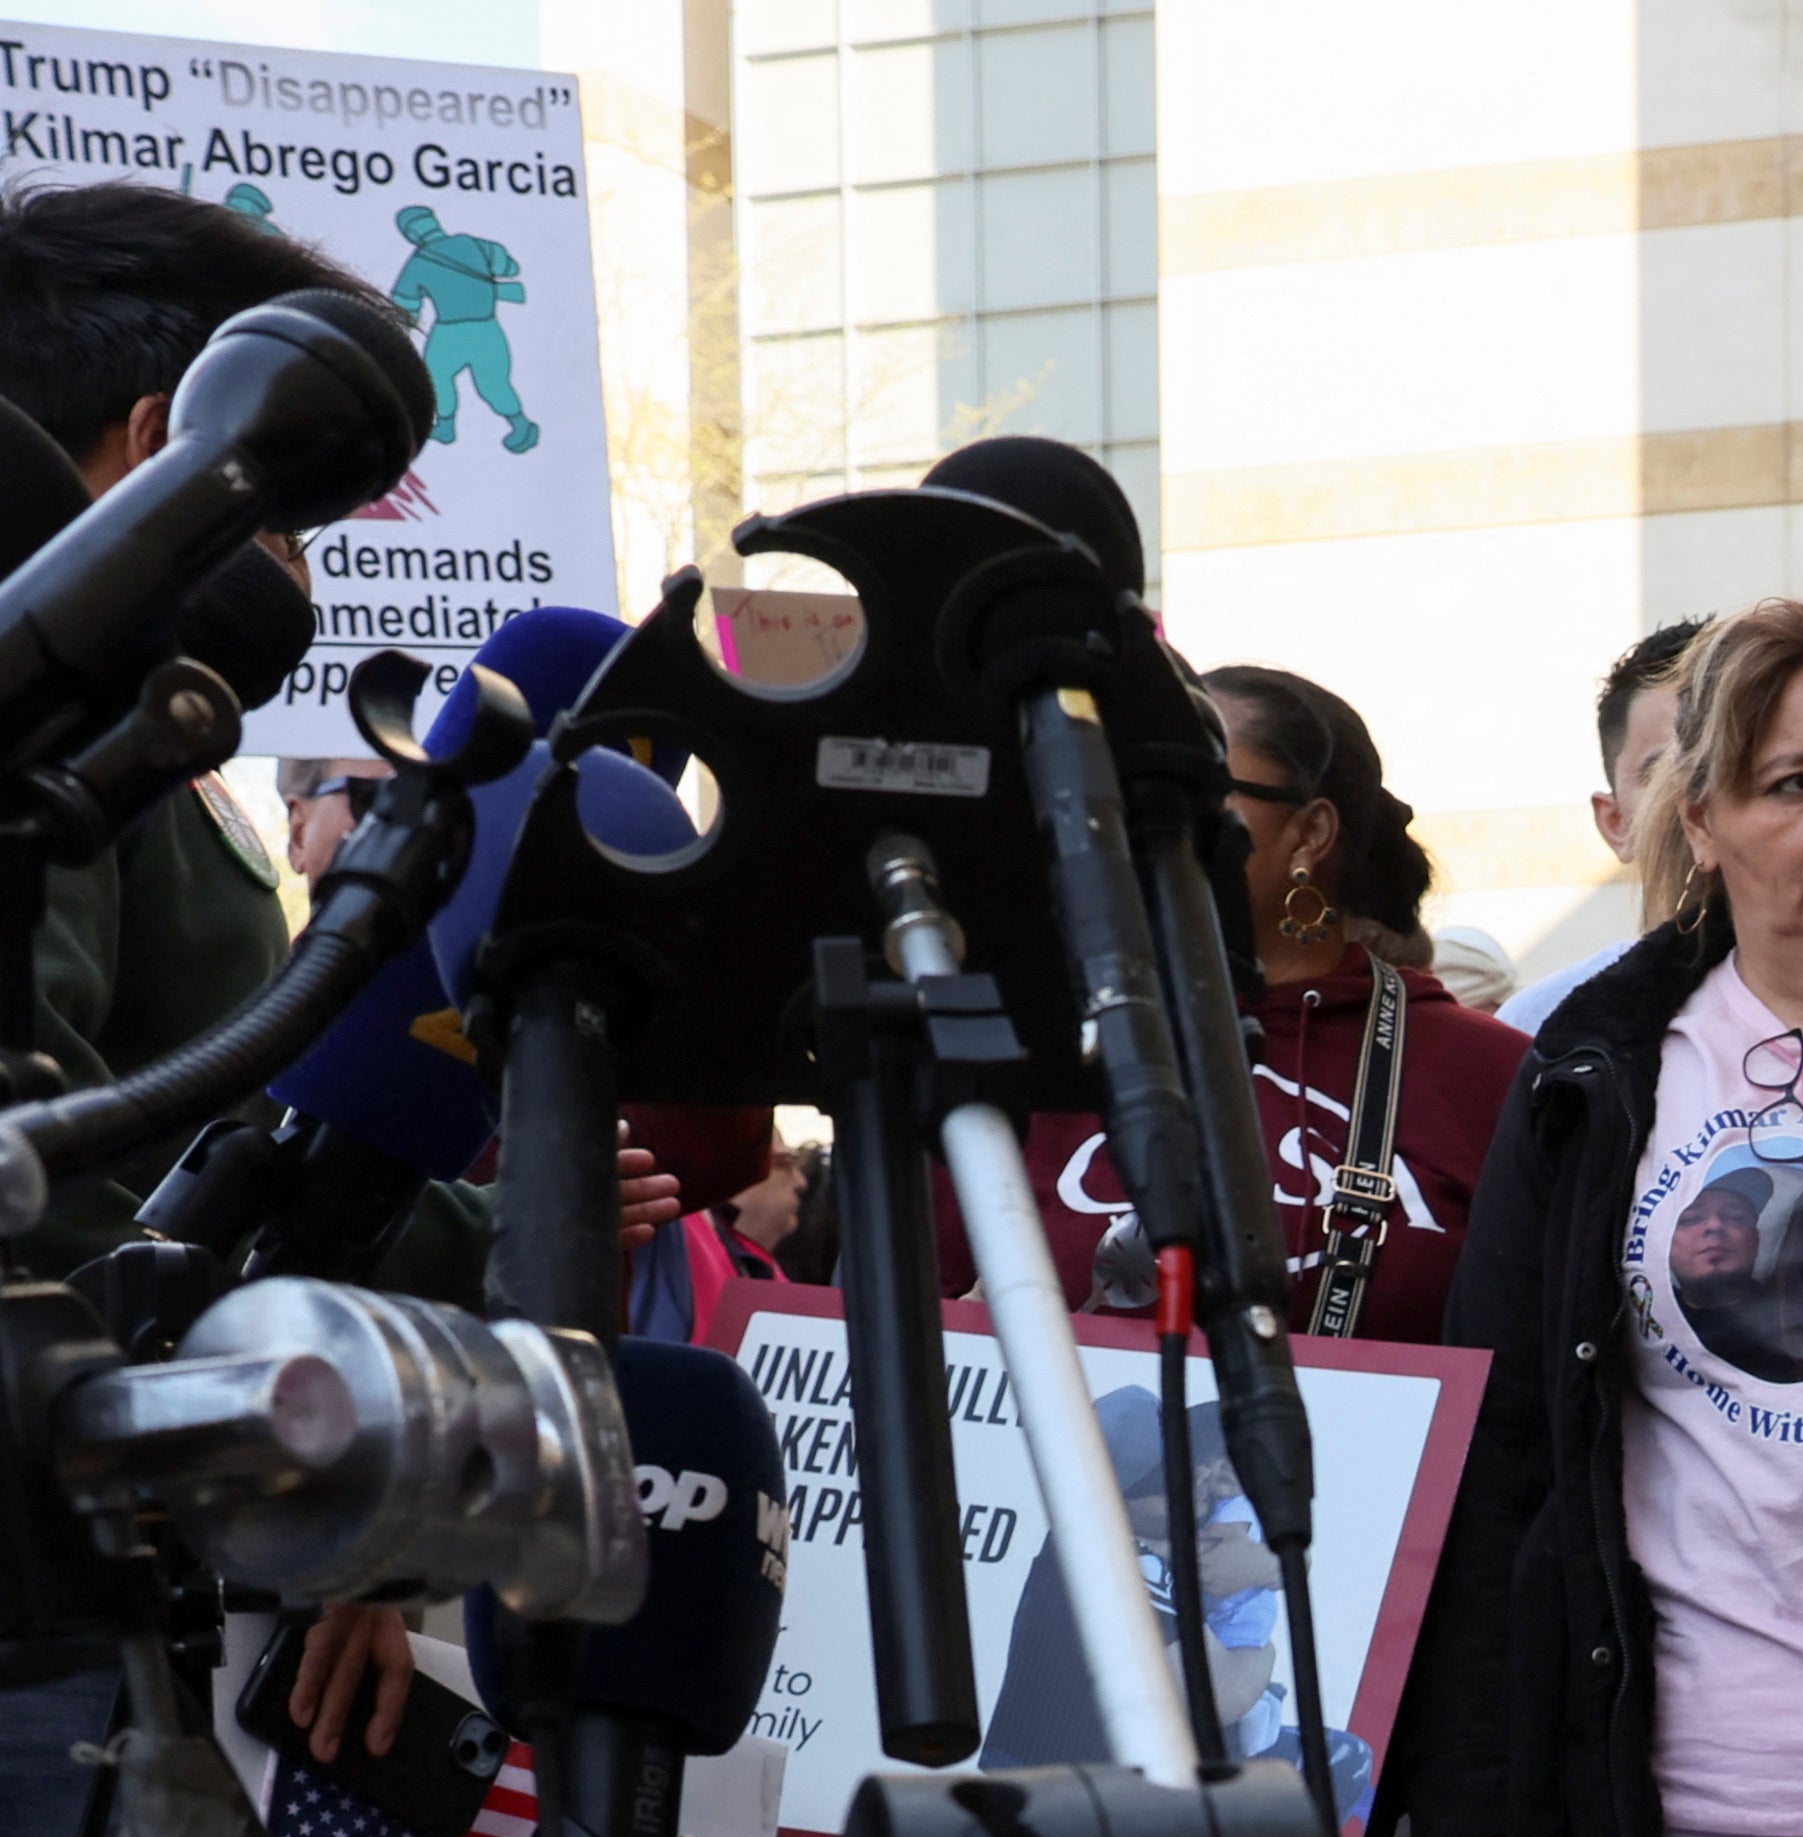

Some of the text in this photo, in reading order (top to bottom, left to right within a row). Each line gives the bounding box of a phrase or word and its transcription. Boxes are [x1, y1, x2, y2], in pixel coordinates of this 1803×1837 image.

[0, 41, 170, 110] Trump
[203, 127, 394, 195] Abrego
[413, 143, 578, 198] Garcia
[321, 534, 554, 584] demands
[1375, 995, 1398, 1051] ANNE
[1624, 1166, 1682, 1264] Bring
[1663, 1345, 1743, 1423] Home
[773, 1663, 812, 1697] to
